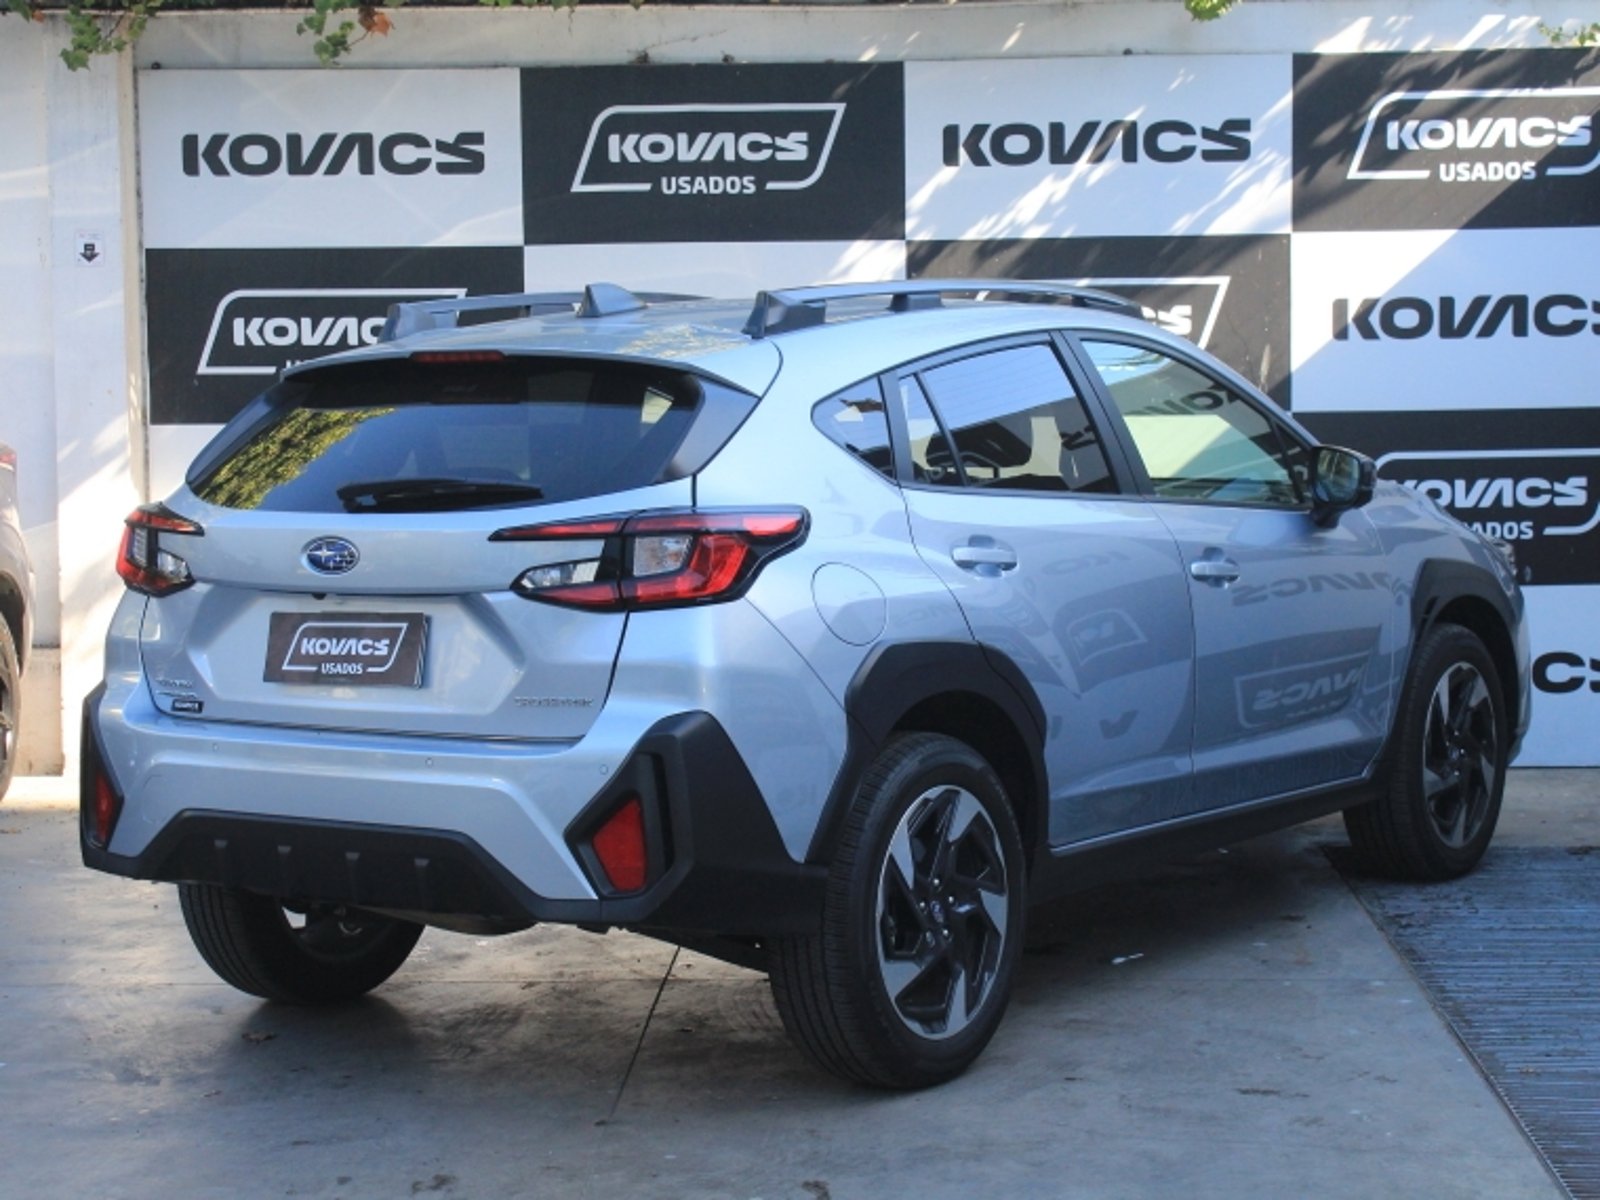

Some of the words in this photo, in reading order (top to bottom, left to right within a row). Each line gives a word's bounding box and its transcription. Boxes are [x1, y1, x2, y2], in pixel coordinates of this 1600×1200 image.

[608, 132, 808, 163] KOVACS
[943, 118, 1251, 167] KOVACS
[1387, 115, 1592, 150] KOVACS
[182, 132, 485, 176] KOVACS
[661, 176, 756, 194] USADOS
[1439, 161, 1537, 182] USADOS
[233, 317, 387, 346] KOVAC
[1332, 294, 1600, 341] KOVAC
[1404, 476, 1588, 508] OVACS
[1465, 521, 1533, 539] ADOS
[300, 637, 390, 655] KOVACS
[321, 663, 363, 674] USADOS
